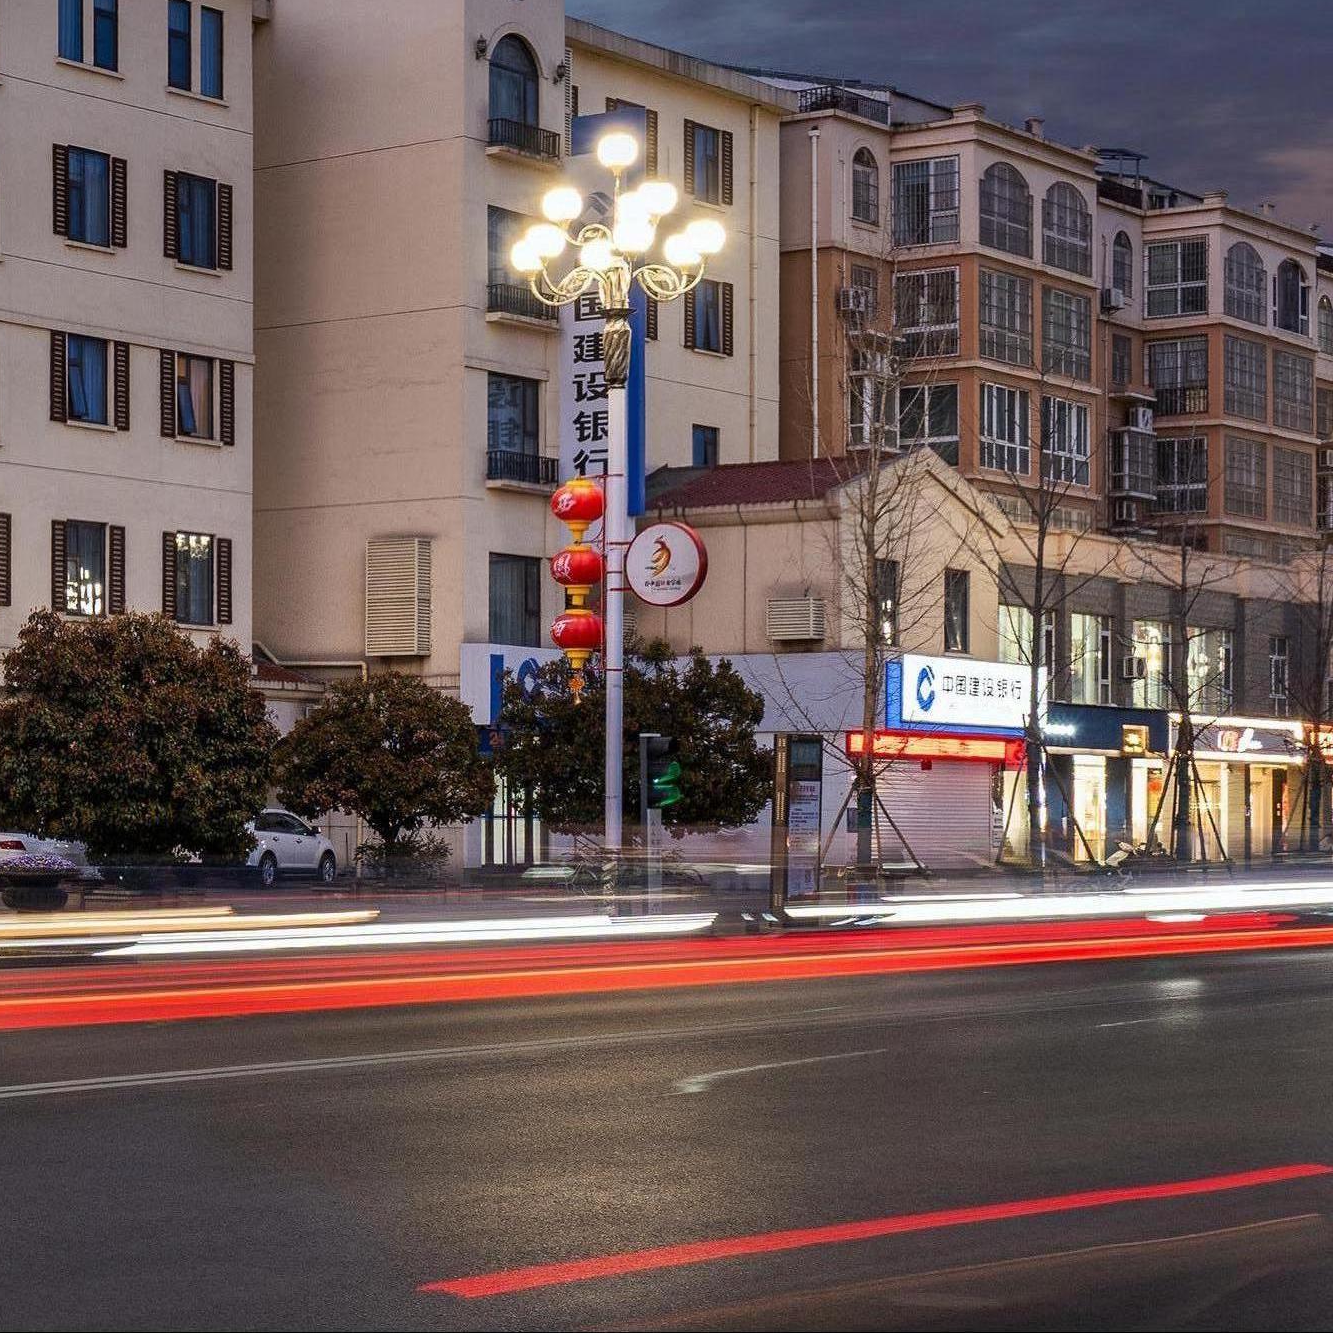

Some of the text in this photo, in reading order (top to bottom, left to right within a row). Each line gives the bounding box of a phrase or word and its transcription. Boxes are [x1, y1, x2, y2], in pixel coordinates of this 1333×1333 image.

[942, 675, 1022, 700] 中国建设银行
